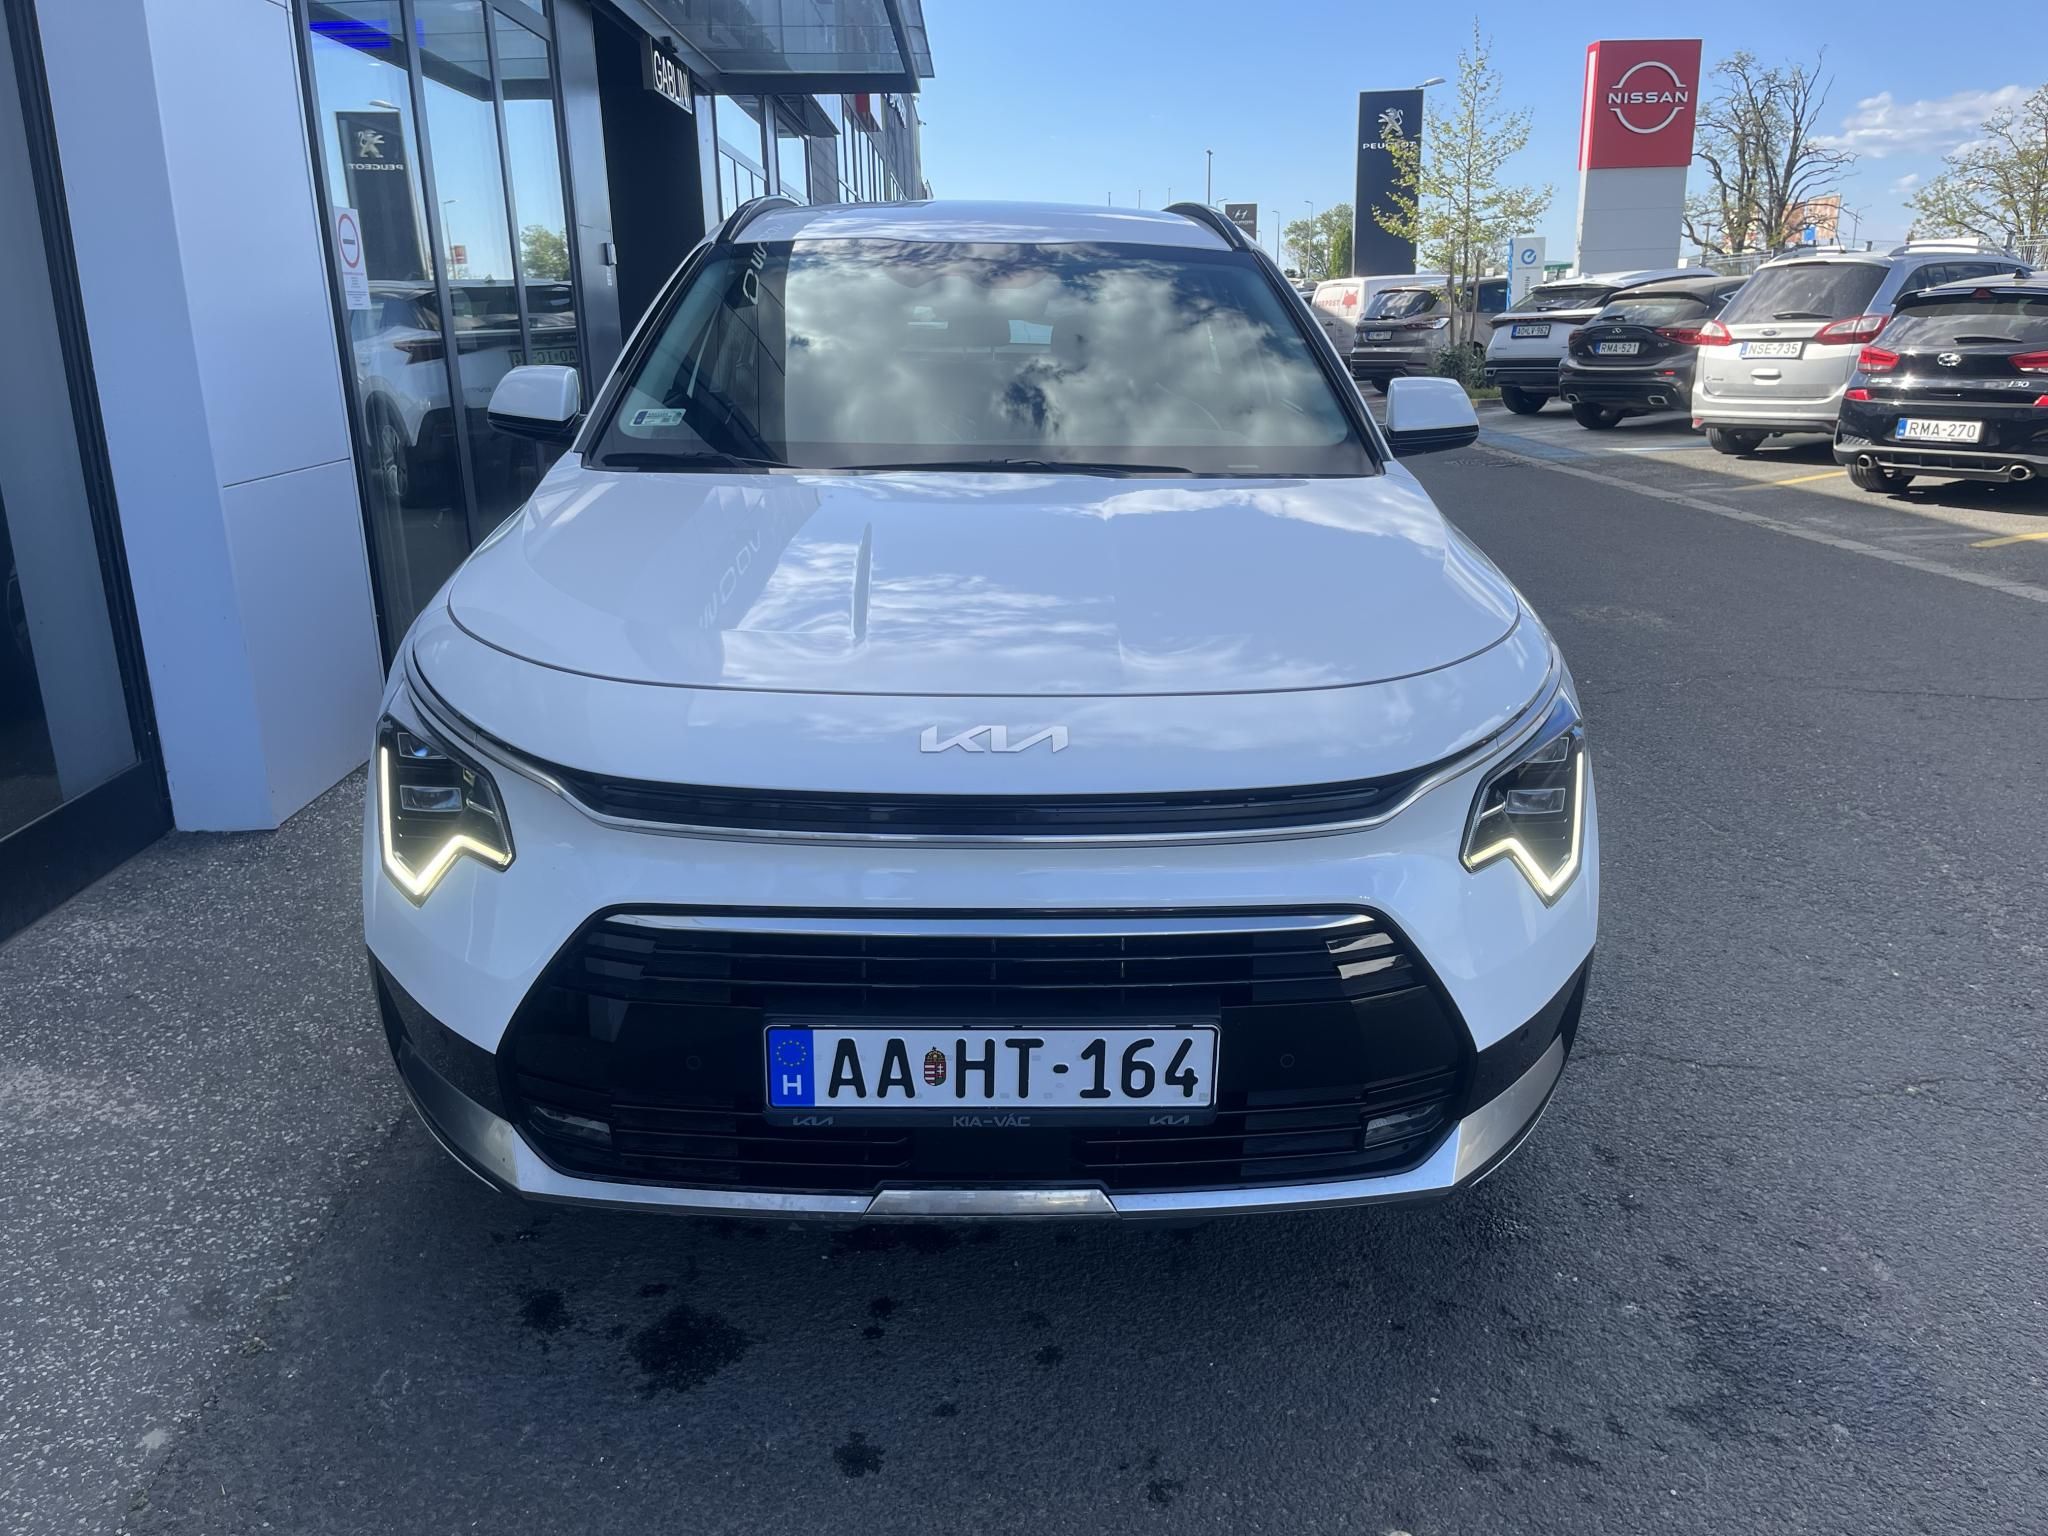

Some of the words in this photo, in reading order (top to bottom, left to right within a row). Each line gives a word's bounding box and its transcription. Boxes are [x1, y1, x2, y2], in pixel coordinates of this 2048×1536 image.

[1607, 91, 1689, 104] NISSAN
[1600, 343, 1637, 353] RMA-521
[1748, 344, 1799, 355] NSE-735
[1908, 421, 1977, 438] RMA-270
[920, 724, 1069, 753] KIA
[782, 1074, 802, 1096] H
[792, 1116, 835, 1127] KIA
[952, 1112, 1031, 1128] KIA-VÁC
[1149, 1114, 1191, 1126] KIA
